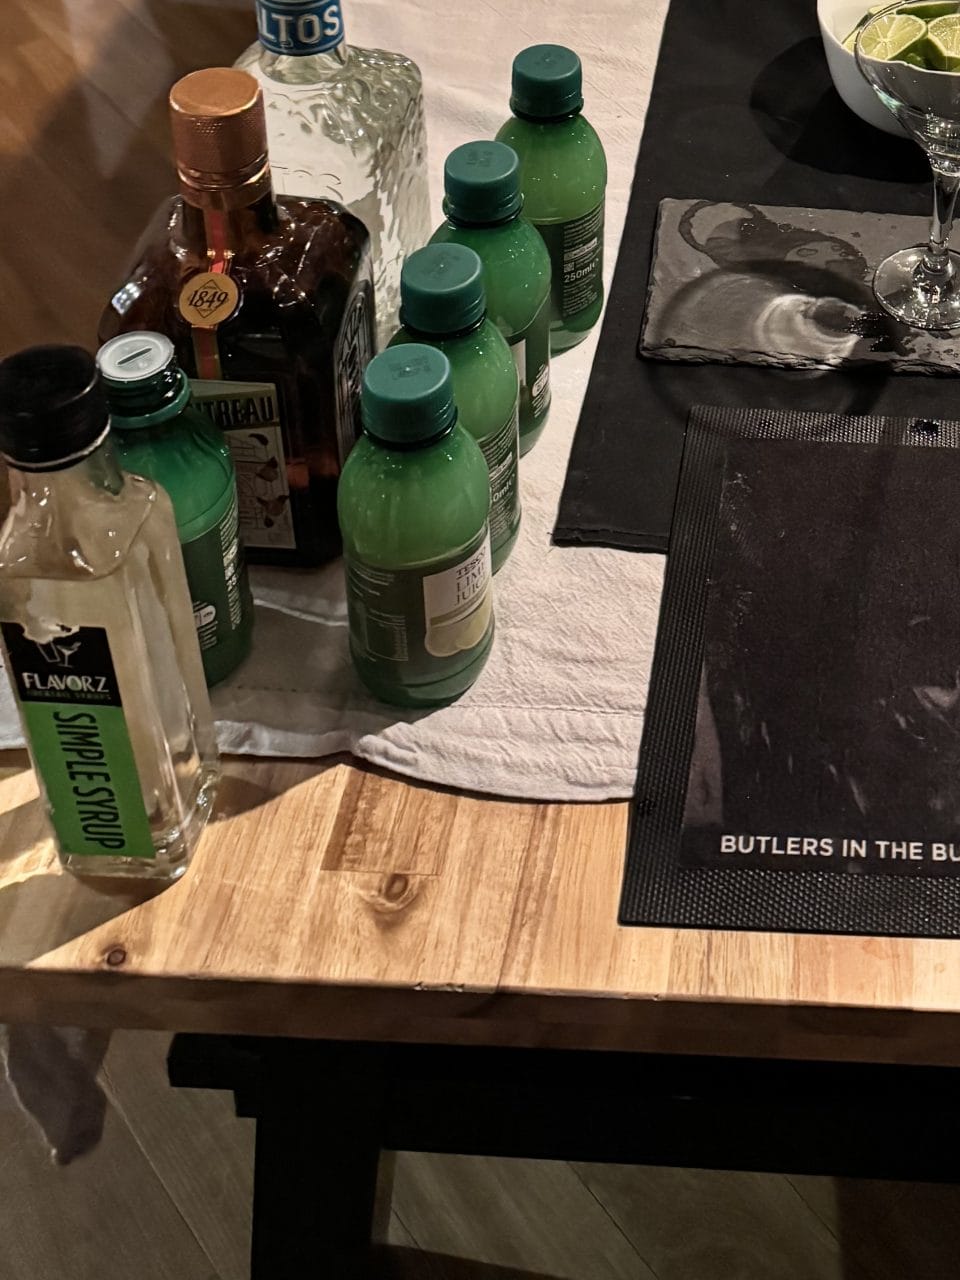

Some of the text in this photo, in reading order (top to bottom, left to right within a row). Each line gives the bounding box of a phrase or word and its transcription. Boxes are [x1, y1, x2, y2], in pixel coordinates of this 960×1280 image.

[258, 5, 340, 44] LTOS
[189, 290, 229, 308] 1849
[53, 711, 126, 850] SIMPLE SYRUP
[720, 835, 834, 857] BUTLERS
[842, 838, 867, 858] IN
[875, 840, 924, 861] THE
